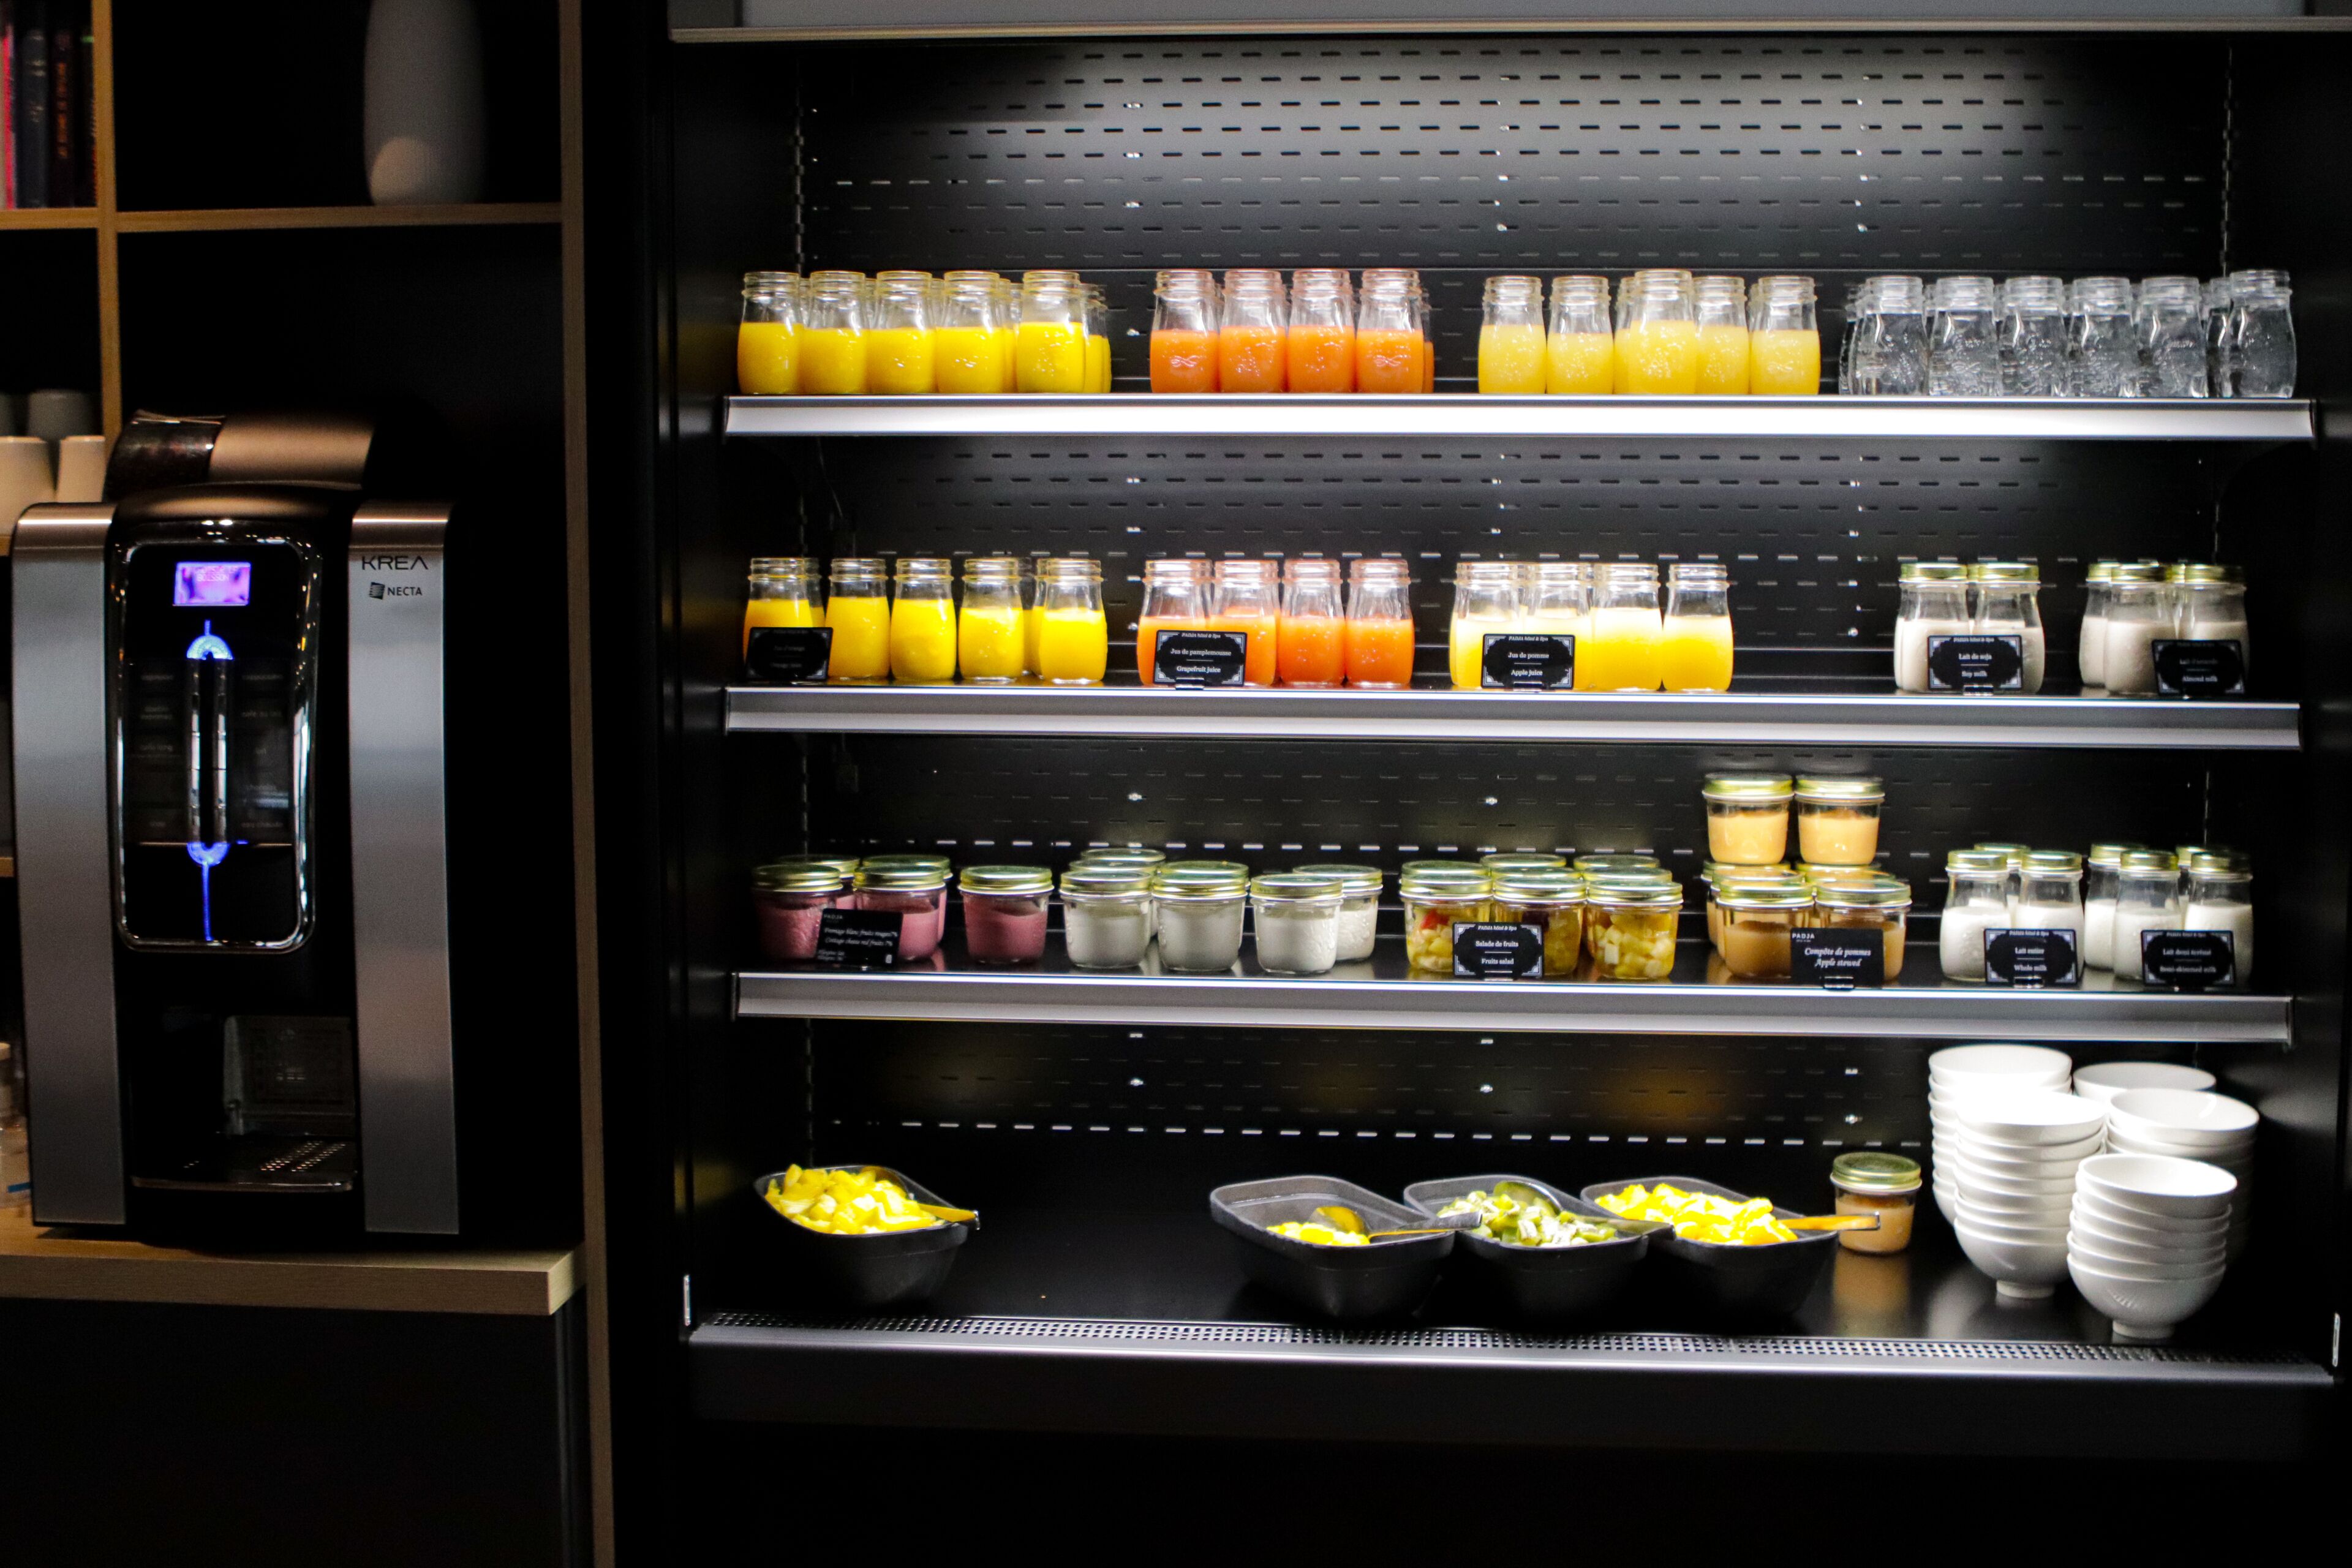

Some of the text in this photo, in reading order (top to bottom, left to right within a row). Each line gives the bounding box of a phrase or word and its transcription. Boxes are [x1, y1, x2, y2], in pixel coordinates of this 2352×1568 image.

[361, 556, 428, 570] KREA
[388, 587, 423, 596] NECTA
[1844, 949, 1871, 958] pommes
[1814, 958, 1836, 968] Apple
